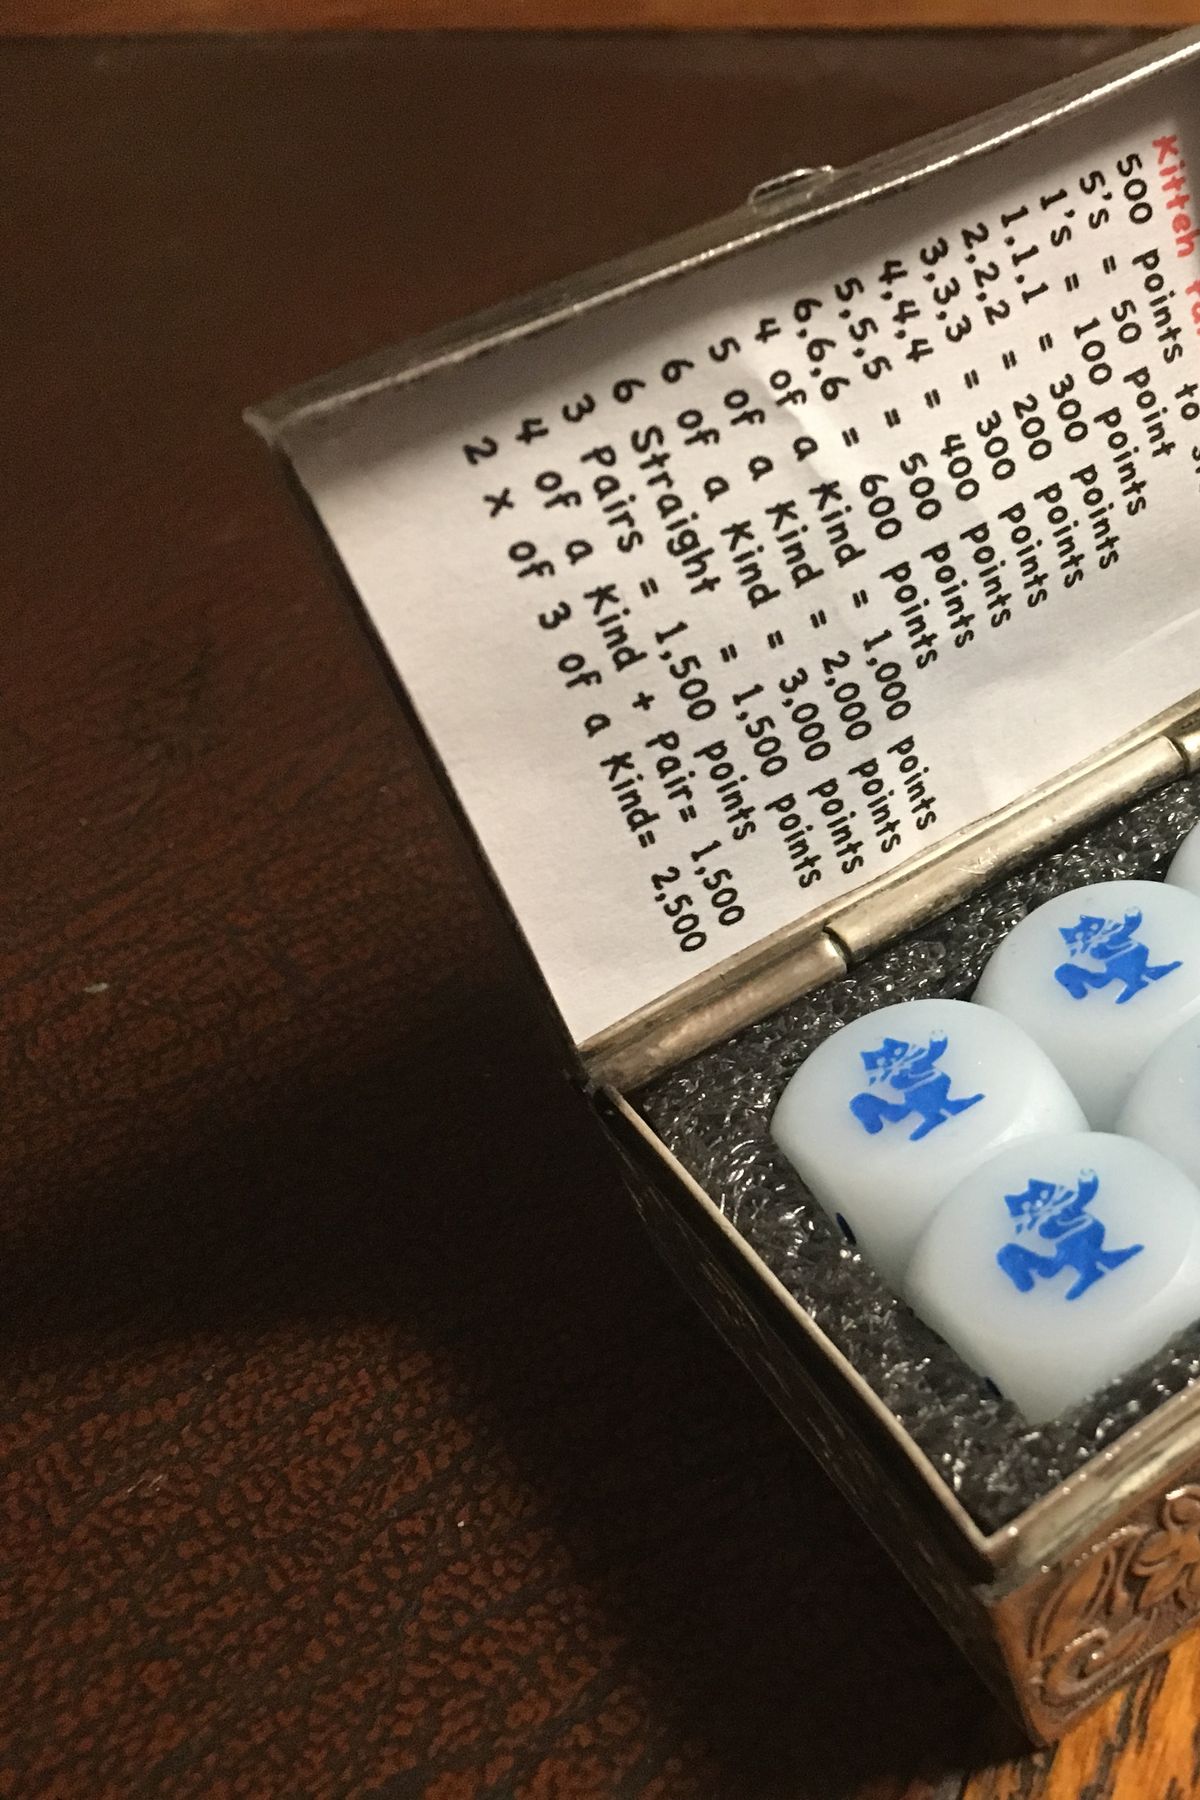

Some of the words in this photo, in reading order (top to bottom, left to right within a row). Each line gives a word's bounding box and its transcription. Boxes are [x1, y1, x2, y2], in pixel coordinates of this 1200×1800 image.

[1079, 170, 1113, 230] 5's
[1116, 153, 1153, 225] 500
[1152, 135, 1200, 257] Kitteh
[1102, 255, 1117, 275] =
[1131, 248, 1183, 364] points
[708, 336, 741, 363] 5
[754, 317, 782, 344] 4
[793, 298, 851, 402] 6,6,6
[834, 277, 893, 380] 5,5,5
[878, 260, 934, 363] 4,4,4
[1040, 188, 1076, 247] 1's
[1064, 272, 1080, 292] =
[1073, 317, 1113, 386] 100
[1093, 406, 1147, 516] points
[1111, 299, 1142, 344] 50
[660, 359, 695, 384] 6
[723, 389, 766, 426] of
[769, 369, 807, 408] of
[924, 388, 941, 409] =
[961, 222, 1010, 326] 2,2,2
[1001, 350, 1017, 370] =
[1012, 393, 1052, 462] 200
[1033, 482, 1085, 589] points
[1000, 205, 1049, 305] 1,1,1
[1038, 332, 1053, 352] =
[1049, 373, 1089, 443] 300
[1069, 463, 1120, 570] points
[1123, 366, 1176, 458] point
[1174, 383, 1200, 421] to
[676, 409, 720, 446] of
[792, 436, 819, 462] a
[841, 427, 860, 447] =
[883, 408, 901, 429] =
[919, 237, 972, 343] 3,3,3
[964, 369, 980, 390] =
[976, 409, 1016, 481] 300
[997, 501, 1049, 608] points
[703, 475, 730, 503] a
[748, 455, 774, 482] a
[859, 474, 902, 541] 600
[899, 452, 942, 521] 500
[940, 433, 980, 502] 400
[719, 519, 781, 610] Kind
[764, 499, 825, 589] Kind
[808, 480, 867, 568] Kind
[561, 393, 596, 423] 3
[580, 444, 644, 554] Pairs
[639, 577, 659, 598] =
[654, 621, 717, 722] 1,500
[693, 739, 757, 841] points
[810, 609, 827, 629] =
[852, 589, 869, 609] =
[879, 561, 938, 670] points
[920, 541, 976, 648] points
[959, 521, 1012, 628] points
[515, 417, 549, 445] 4
[534, 470, 582, 509] of
[565, 539, 594, 566] a
[583, 583, 648, 673] Kind
[632, 691, 655, 711] +
[690, 840, 745, 927] 1,500
[612, 378, 646, 404] 6
[630, 424, 721, 595] Straight
[719, 643, 738, 663] =
[732, 683, 788, 778] 1,500
[764, 792, 822, 889] points
[767, 630, 785, 650] =
[863, 629, 912, 721] 1,000
[462, 436, 498, 466] 2
[483, 487, 515, 518] x
[508, 540, 556, 579] of
[538, 601, 572, 630] 3
[557, 653, 603, 689] of
[584, 713, 611, 738] a
[651, 866, 707, 952] 2,500
[778, 667, 831, 762] 3,000
[821, 650, 872, 741] 2,000
[806, 777, 864, 875] points
[846, 757, 901, 853] points
[886, 735, 937, 831] points
